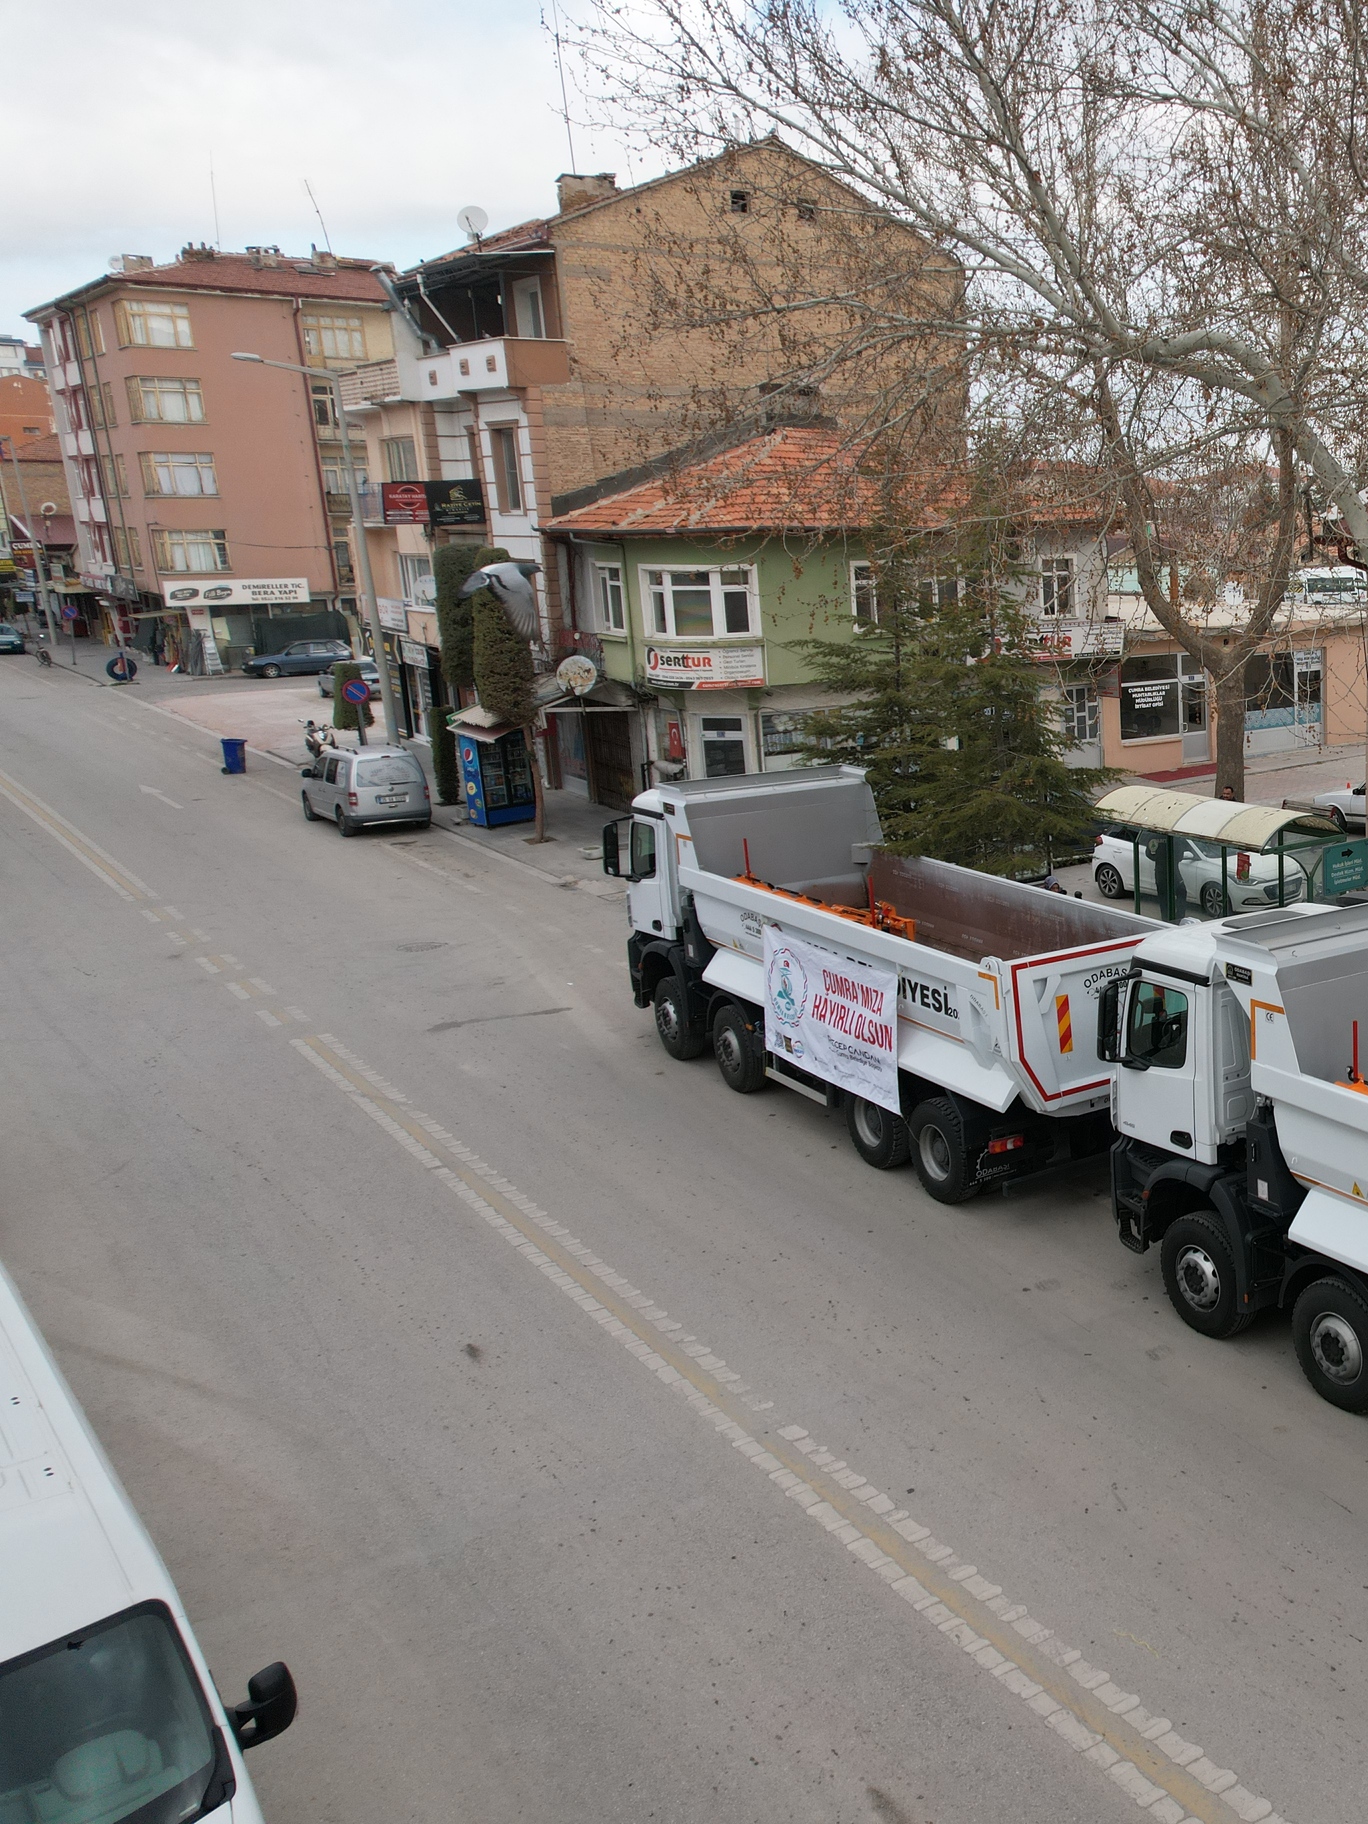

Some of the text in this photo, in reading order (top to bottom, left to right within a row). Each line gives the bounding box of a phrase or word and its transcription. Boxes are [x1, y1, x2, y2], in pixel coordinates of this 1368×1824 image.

[12, 540, 42, 550] ÇUMA
[1083, 967, 1128, 988] ODABAŞ
[823, 969, 884, 1017] ÇUMRA'MIZA
[812, 994, 893, 1053] HAYIRLI OLSUN
[948, 1007, 960, 1020] 20
